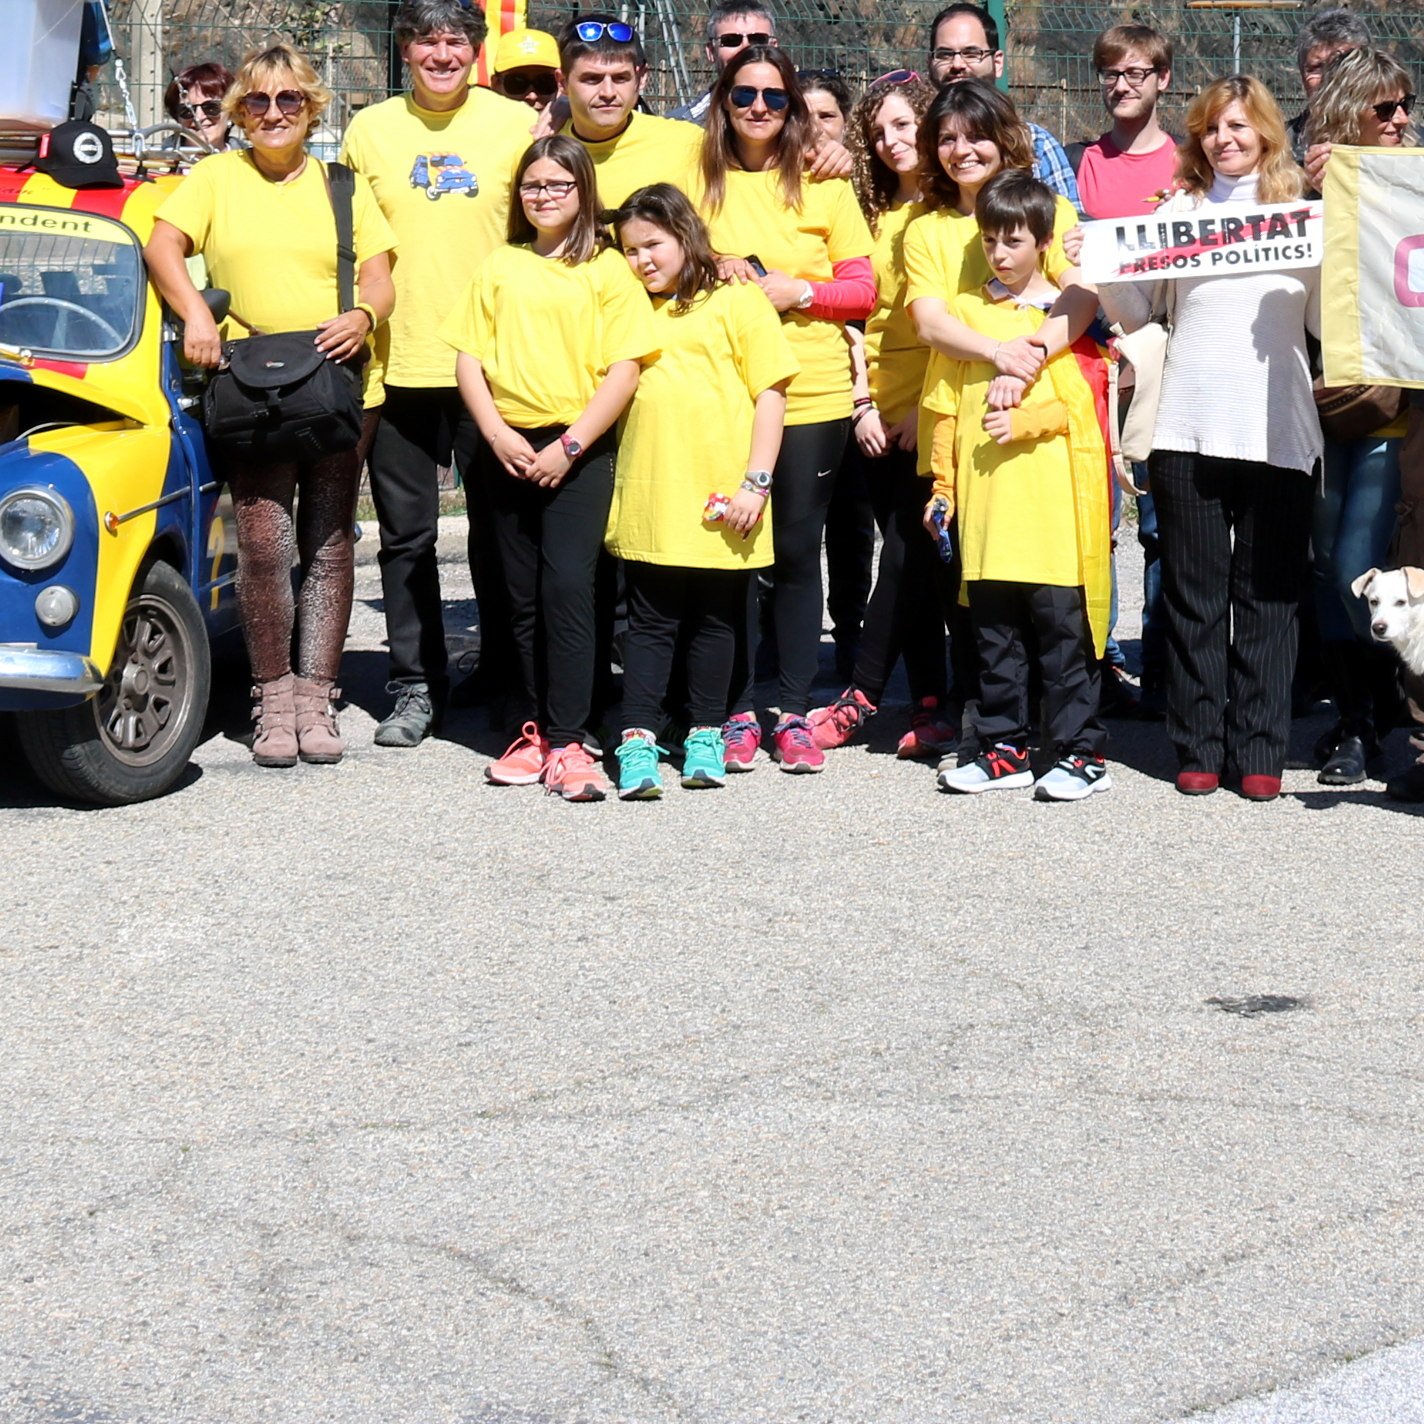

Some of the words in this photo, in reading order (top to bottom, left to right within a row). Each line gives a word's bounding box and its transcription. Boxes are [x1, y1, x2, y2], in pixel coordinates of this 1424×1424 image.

[1115, 210, 1311, 252] LLIBERTAT
[1119, 253, 1201, 274] PRESOS
[1211, 243, 1312, 266] POLÍTICS!
